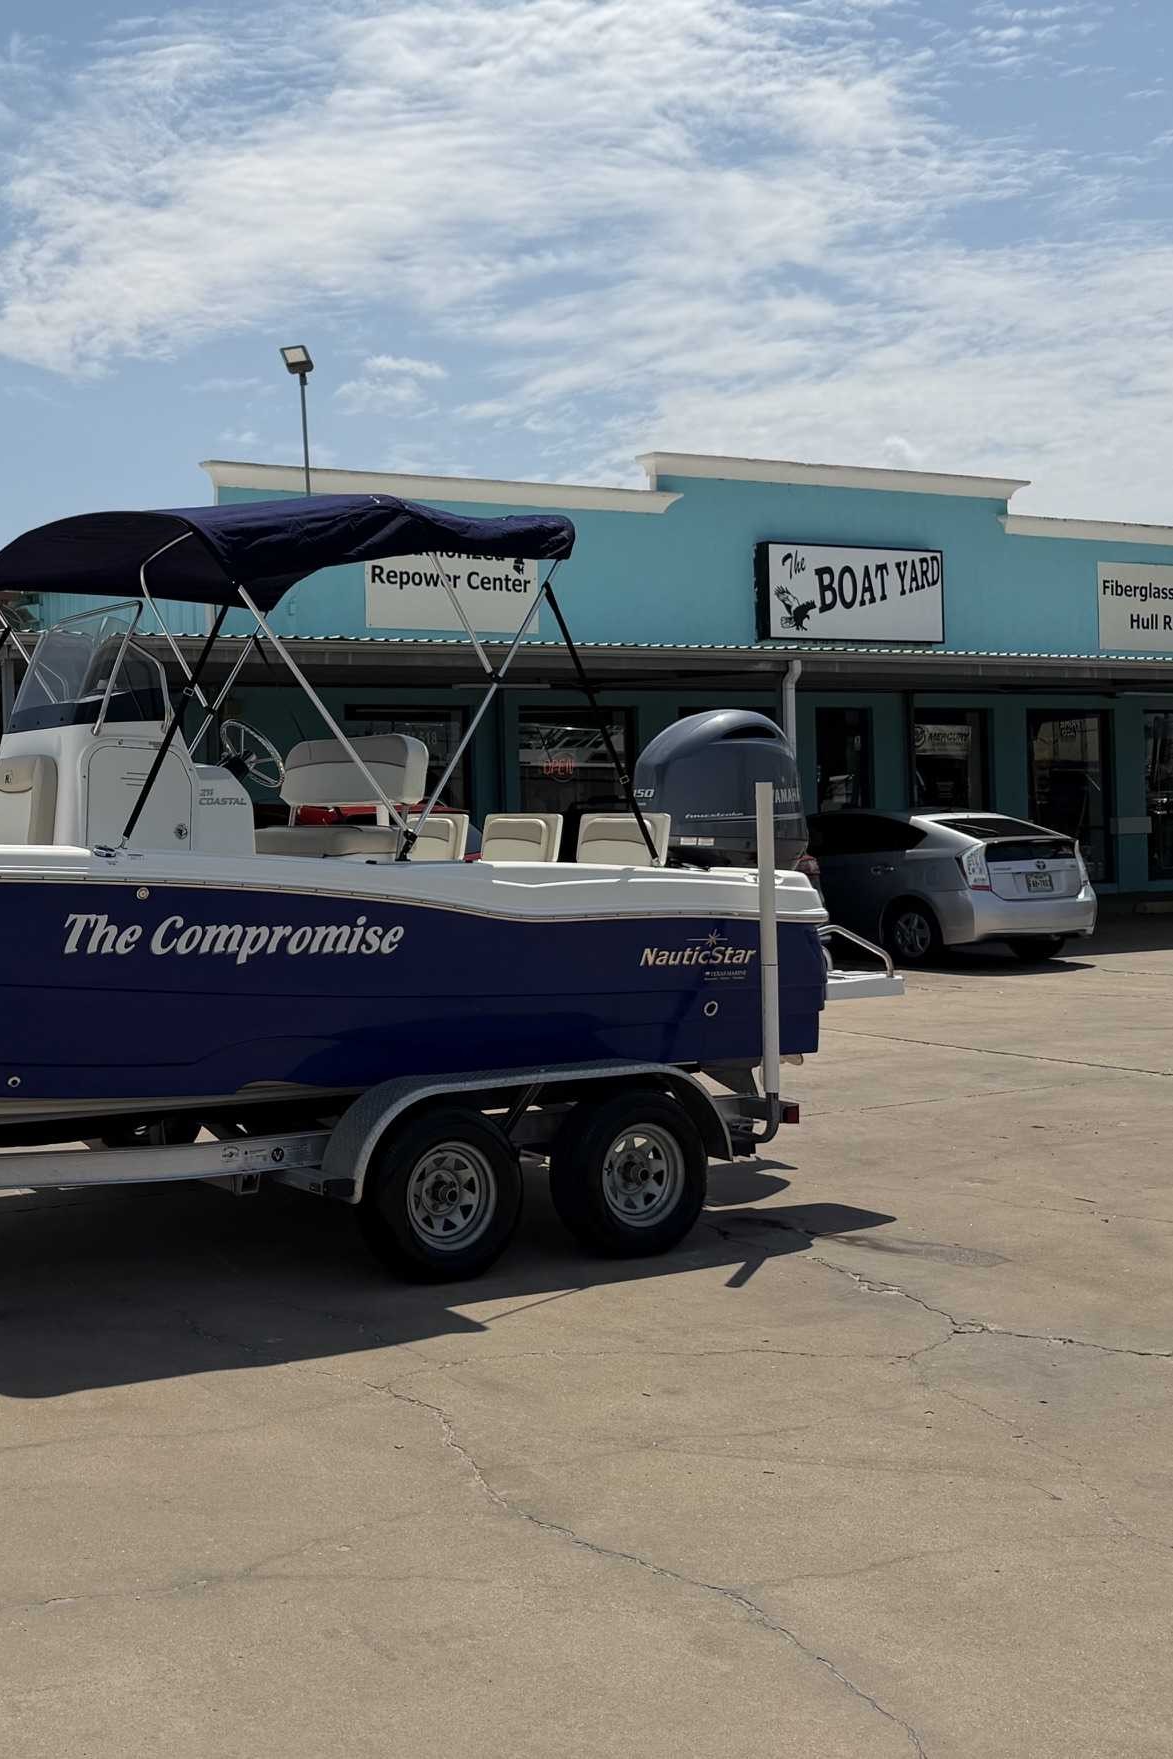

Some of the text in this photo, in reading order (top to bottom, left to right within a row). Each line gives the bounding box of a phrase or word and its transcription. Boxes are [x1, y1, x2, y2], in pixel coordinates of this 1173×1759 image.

[781, 550, 806, 580] The
[371, 564, 531, 593] Repower Center
[814, 555, 940, 614] BOAT YARD
[1102, 579, 1173, 602] Fiberglass
[1130, 613, 1158, 630] Hull
[199, 797, 247, 806] COASTAL
[63, 913, 405, 965] The Compromise
[639, 946, 757, 967] NauticStar
